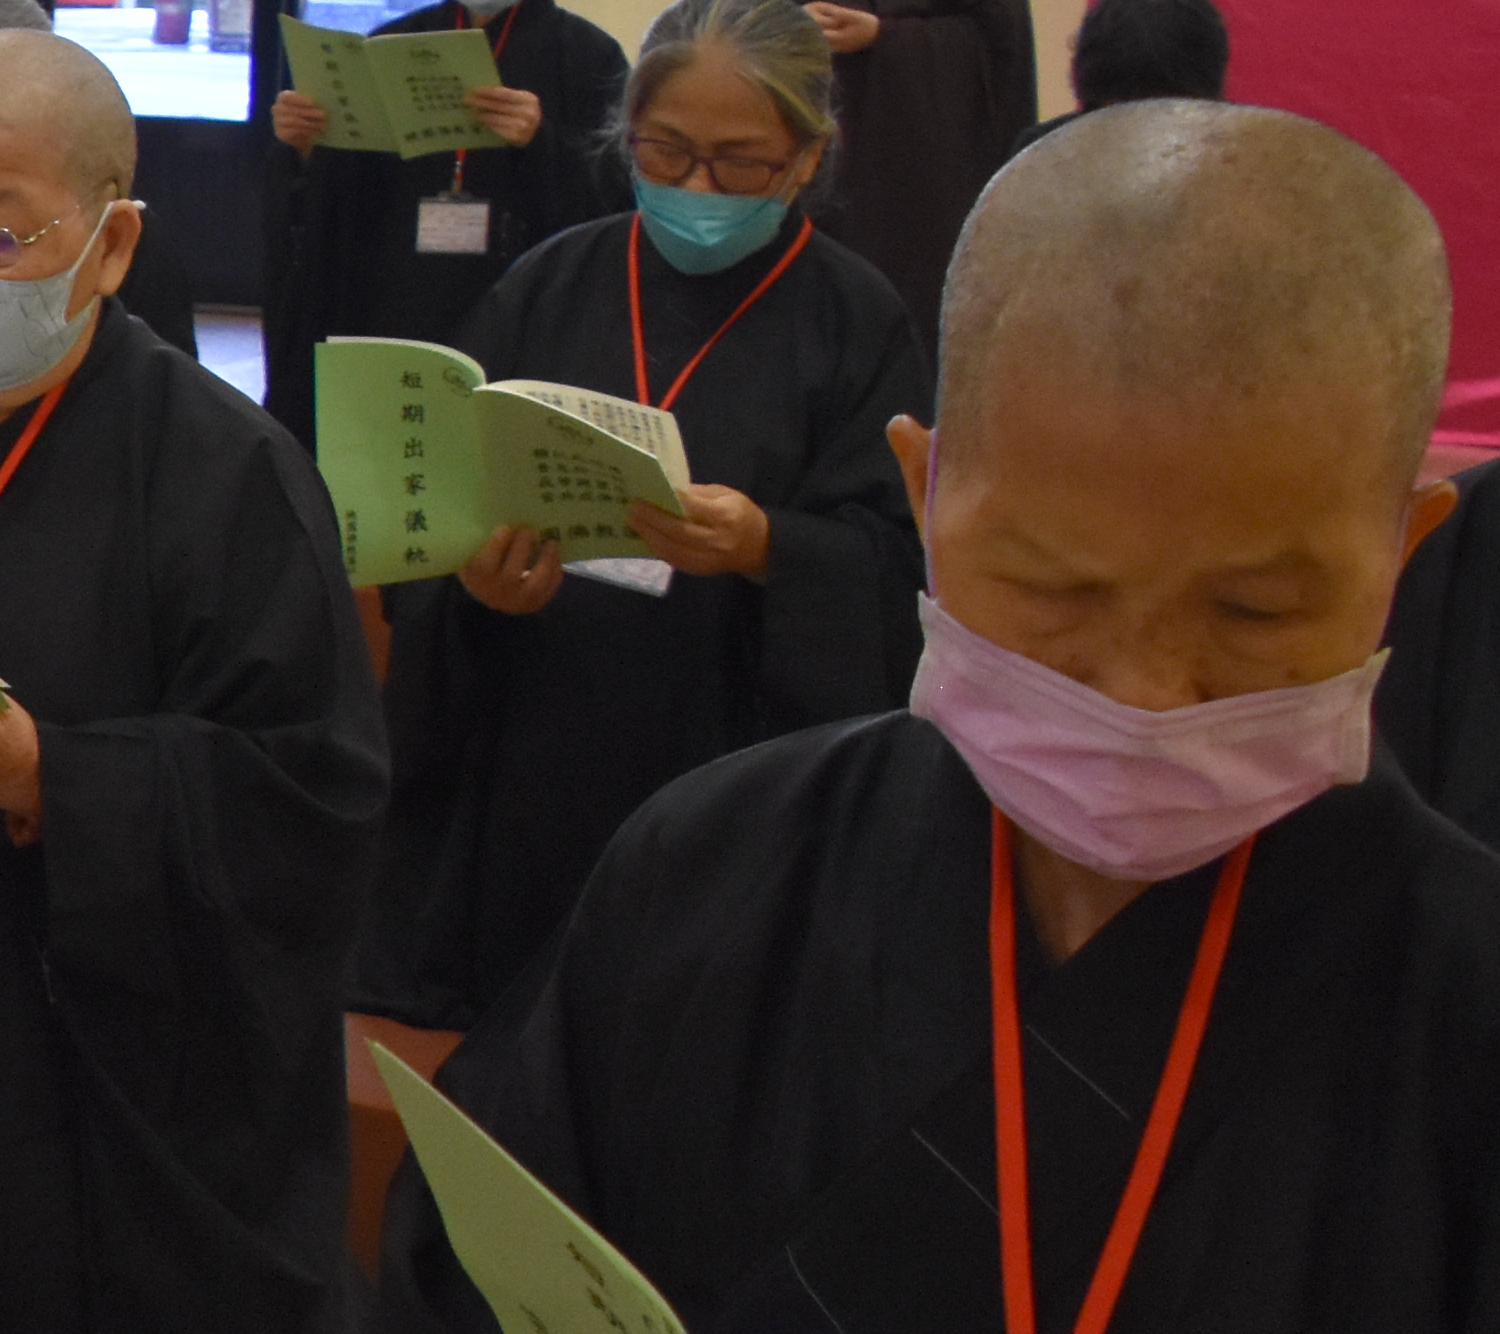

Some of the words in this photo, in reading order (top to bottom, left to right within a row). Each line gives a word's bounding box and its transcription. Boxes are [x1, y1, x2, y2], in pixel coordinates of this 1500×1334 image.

[401, 370, 429, 565] 短期出家儀軌
